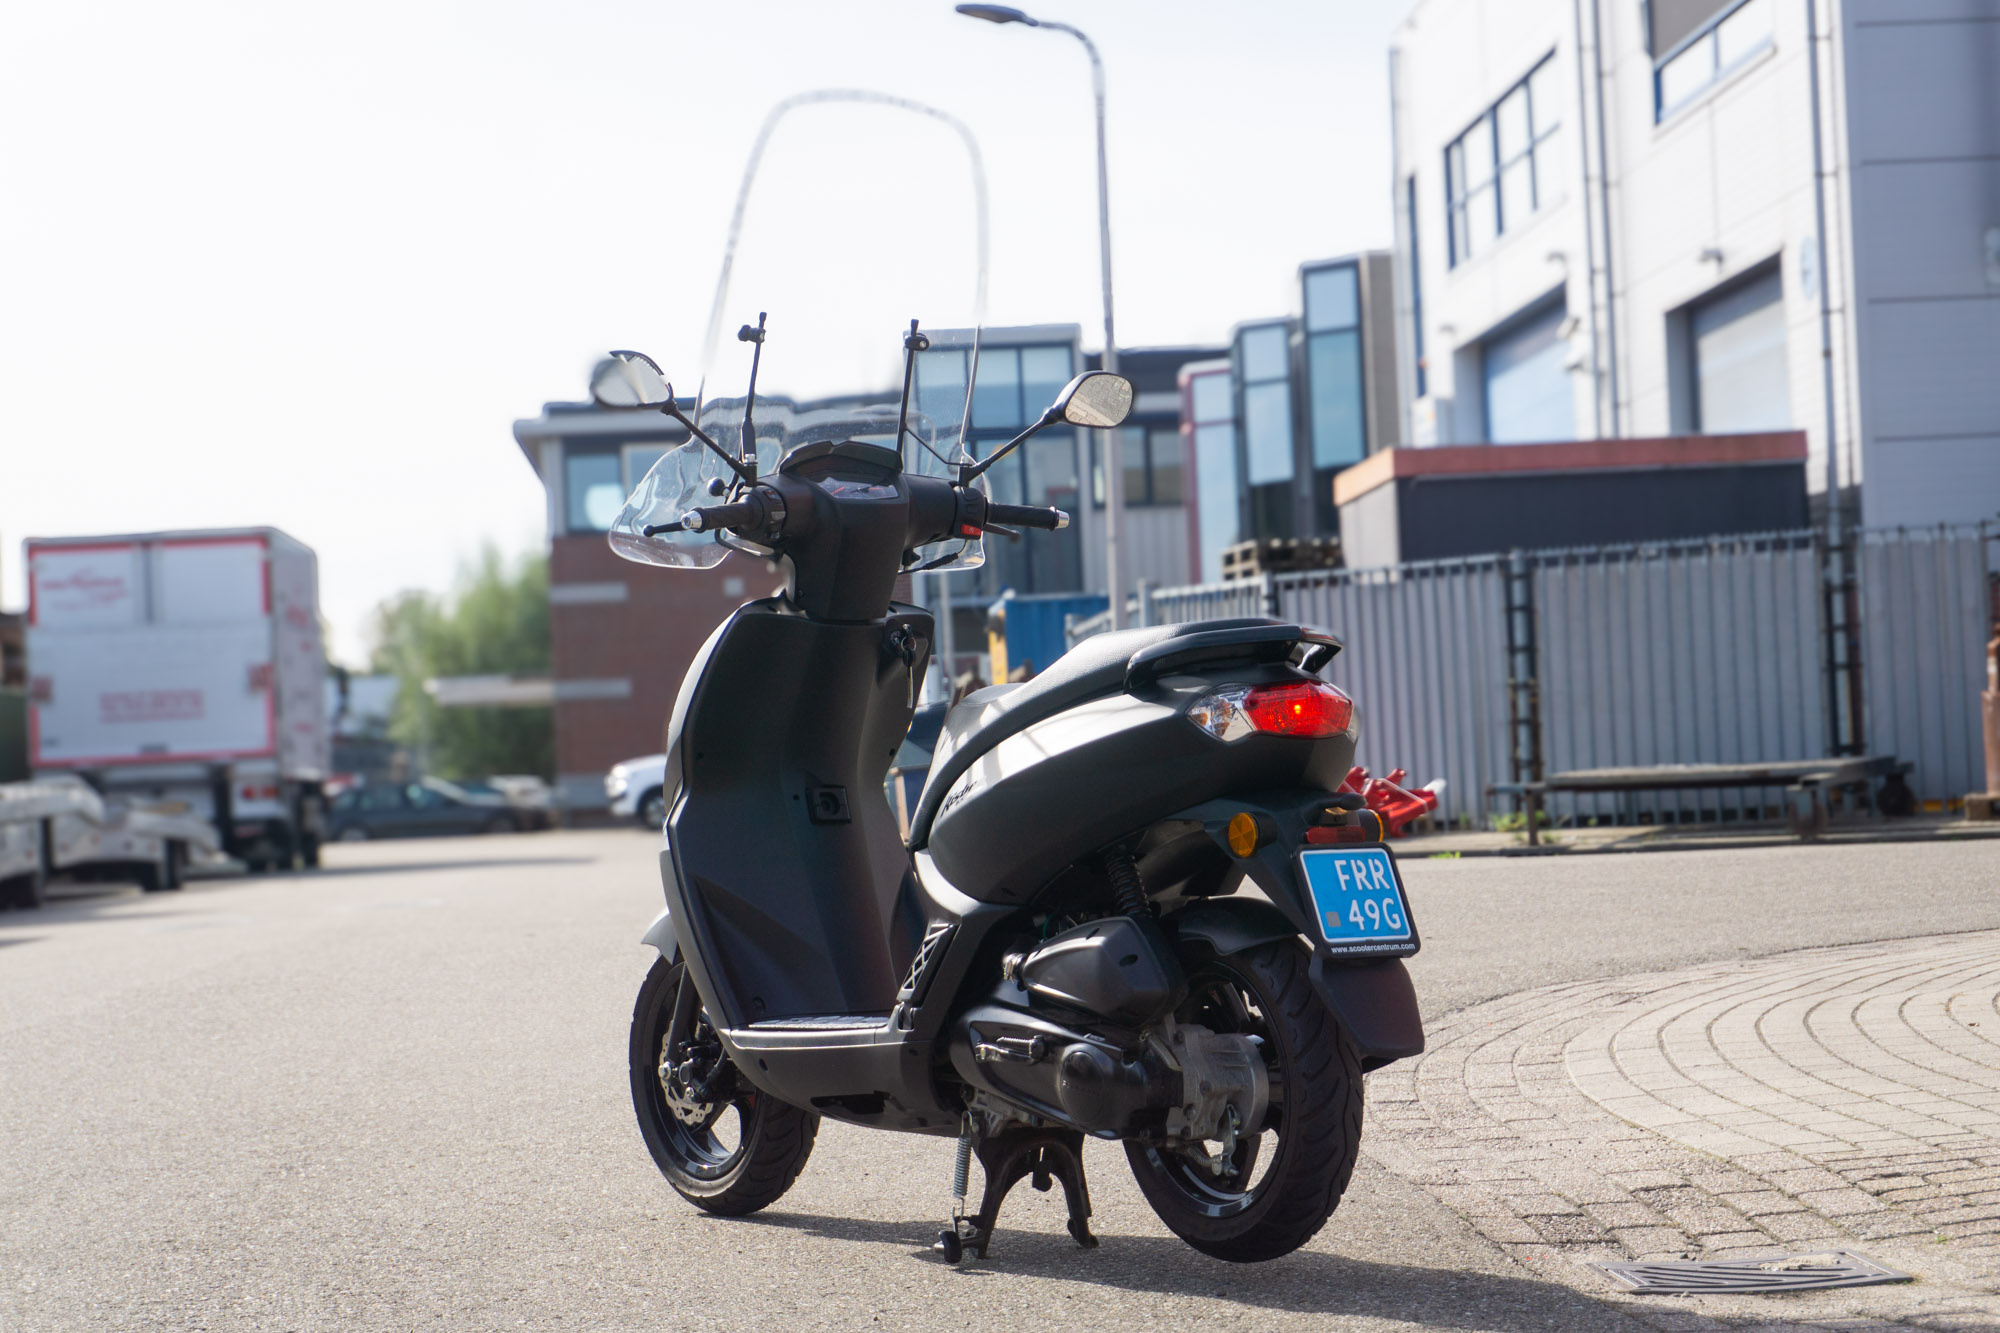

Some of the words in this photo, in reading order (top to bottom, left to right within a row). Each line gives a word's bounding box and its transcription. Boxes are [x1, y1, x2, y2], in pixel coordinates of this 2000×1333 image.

[1334, 858, 1390, 891] FRR
[1349, 897, 1402, 931] 49G
[1331, 943, 1416, 954] www.scootercentrum.com
